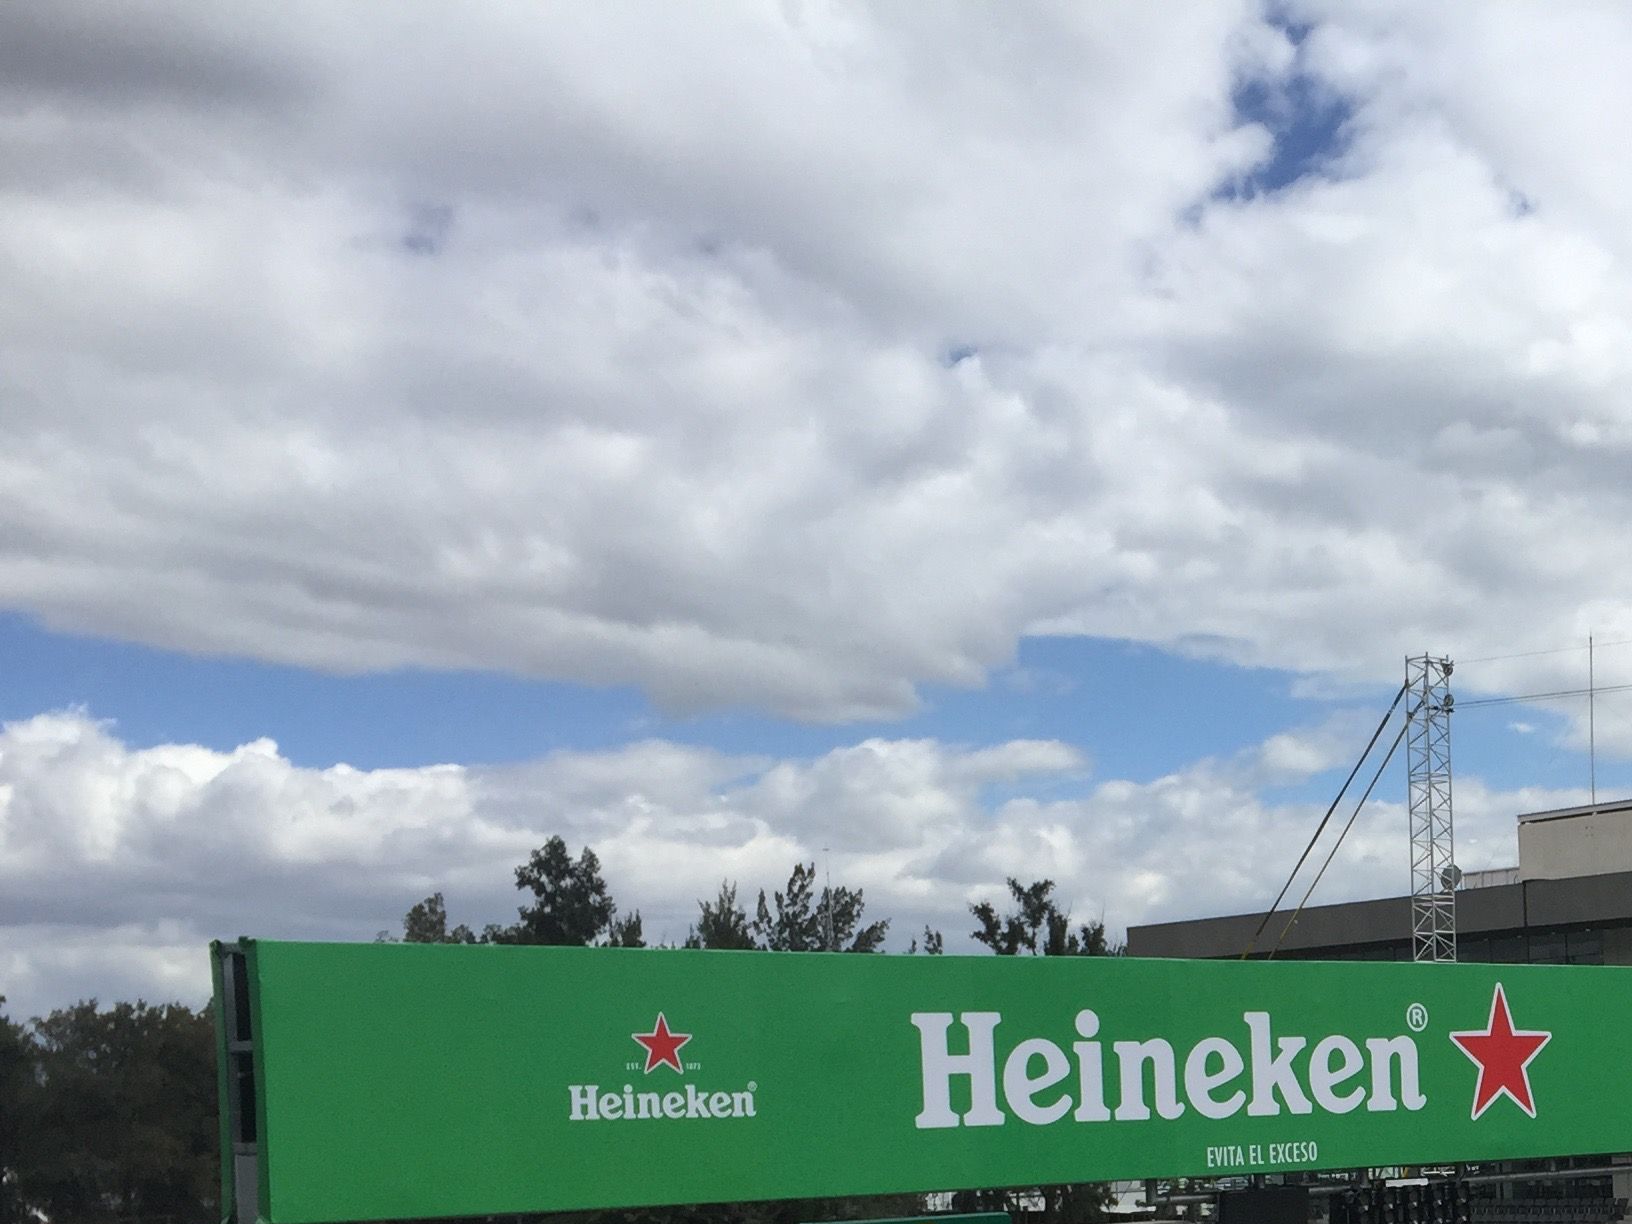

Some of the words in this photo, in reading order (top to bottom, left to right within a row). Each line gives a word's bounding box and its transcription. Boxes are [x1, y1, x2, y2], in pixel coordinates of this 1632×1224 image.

[1207, 1146, 1244, 1168] EVITA
[1250, 1144, 1264, 1165] EL
[1269, 1141, 1318, 1164] EXCESO
